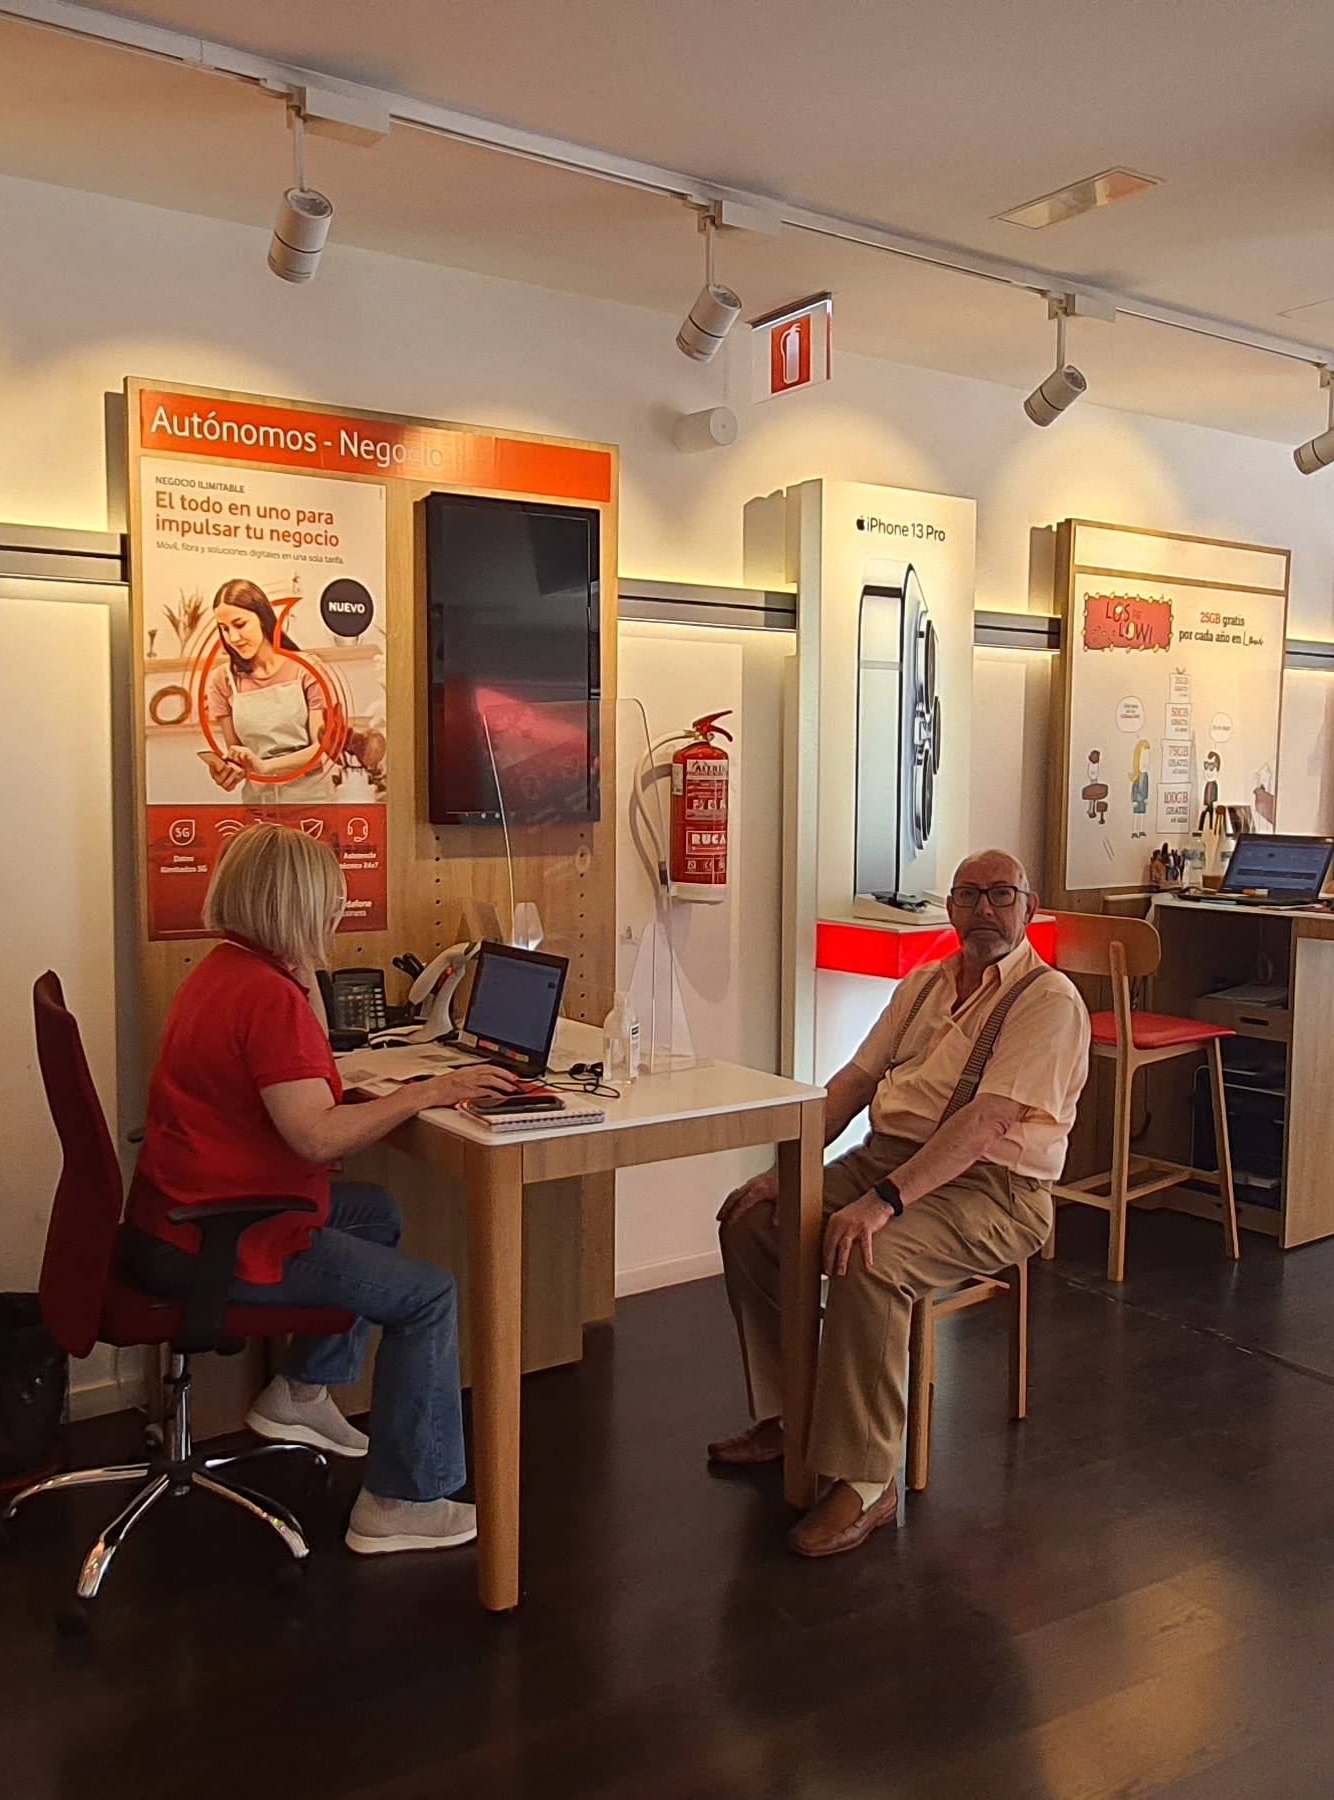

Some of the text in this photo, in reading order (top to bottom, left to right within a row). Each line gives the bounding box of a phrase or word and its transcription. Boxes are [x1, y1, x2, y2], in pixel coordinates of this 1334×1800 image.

[150, 405, 317, 452] Autónomos
[155, 476, 196, 489] NEGOCIO
[156, 491, 334, 526] El todo en uno para
[156, 513, 340, 548] impulsar tu negocio
[867, 516, 946, 541] iPhone 13 Pro
[329, 601, 366, 614] NUEVO
[1200, 611, 1245, 628] 25GB gratis
[1179, 630, 1193, 642] por
[1194, 631, 1214, 642] cada
[1215, 634, 1230, 643] año
[1231, 636, 1242, 644] en
[175, 827, 190, 838] 5G
